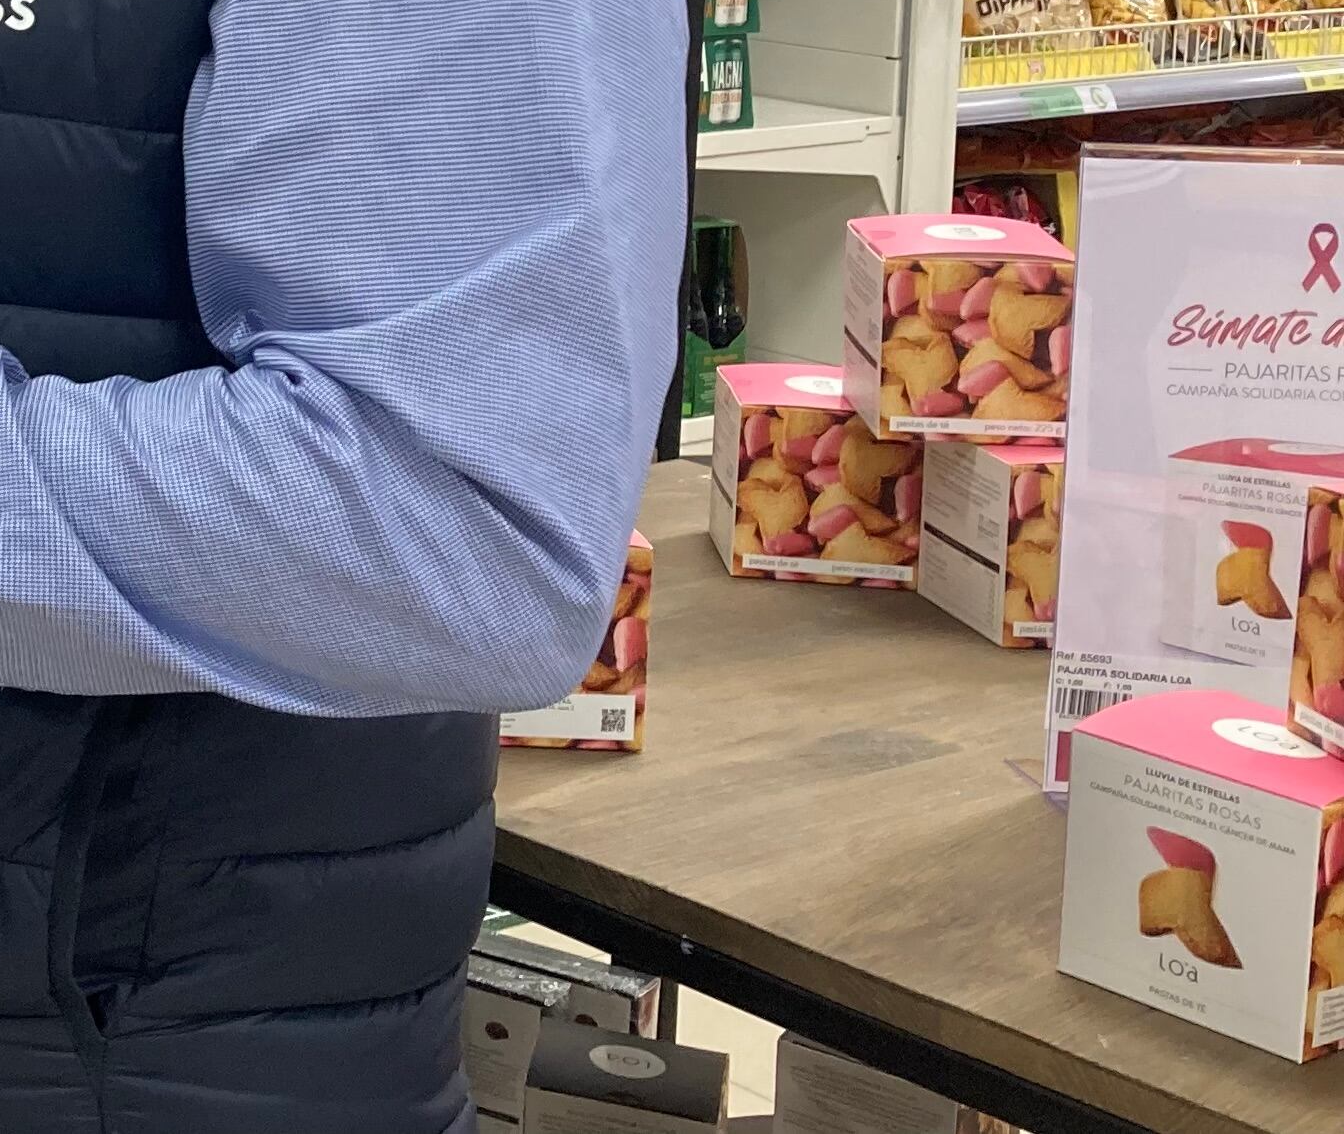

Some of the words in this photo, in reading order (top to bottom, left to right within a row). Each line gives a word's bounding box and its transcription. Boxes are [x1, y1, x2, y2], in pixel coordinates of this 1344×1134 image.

[1166, 303, 1319, 355] Súmate
[1224, 361, 1331, 383] PAJARITAS
[1166, 382, 1239, 399] CAMPAÑA
[1241, 387, 1316, 402] SOLIDARIA
[1242, 476, 1253, 484] DE
[1253, 477, 1291, 489] ESTRELLAS
[1202, 482, 1263, 501] PAJARITAS
[1266, 491, 1306, 507] ROSAS
[1080, 652, 1113, 665] 85693
[1057, 665, 1108, 678] PAJARITA
[1109, 670, 1168, 684] SOLIDARIA
[1170, 675, 1193, 685] LOA
[1145, 766, 1176, 783] LLUVIA
[1177, 776, 1191, 788] DE
[1192, 781, 1241, 805] ESTRELLAS
[1123, 774, 1204, 811] PAJARITAS
[1208, 801, 1262, 831] ROSAS
[1172, 809, 1208, 828] CONTRA
[1148, 985, 1180, 1004] PASTAS
[1181, 998, 1194, 1009] DE
